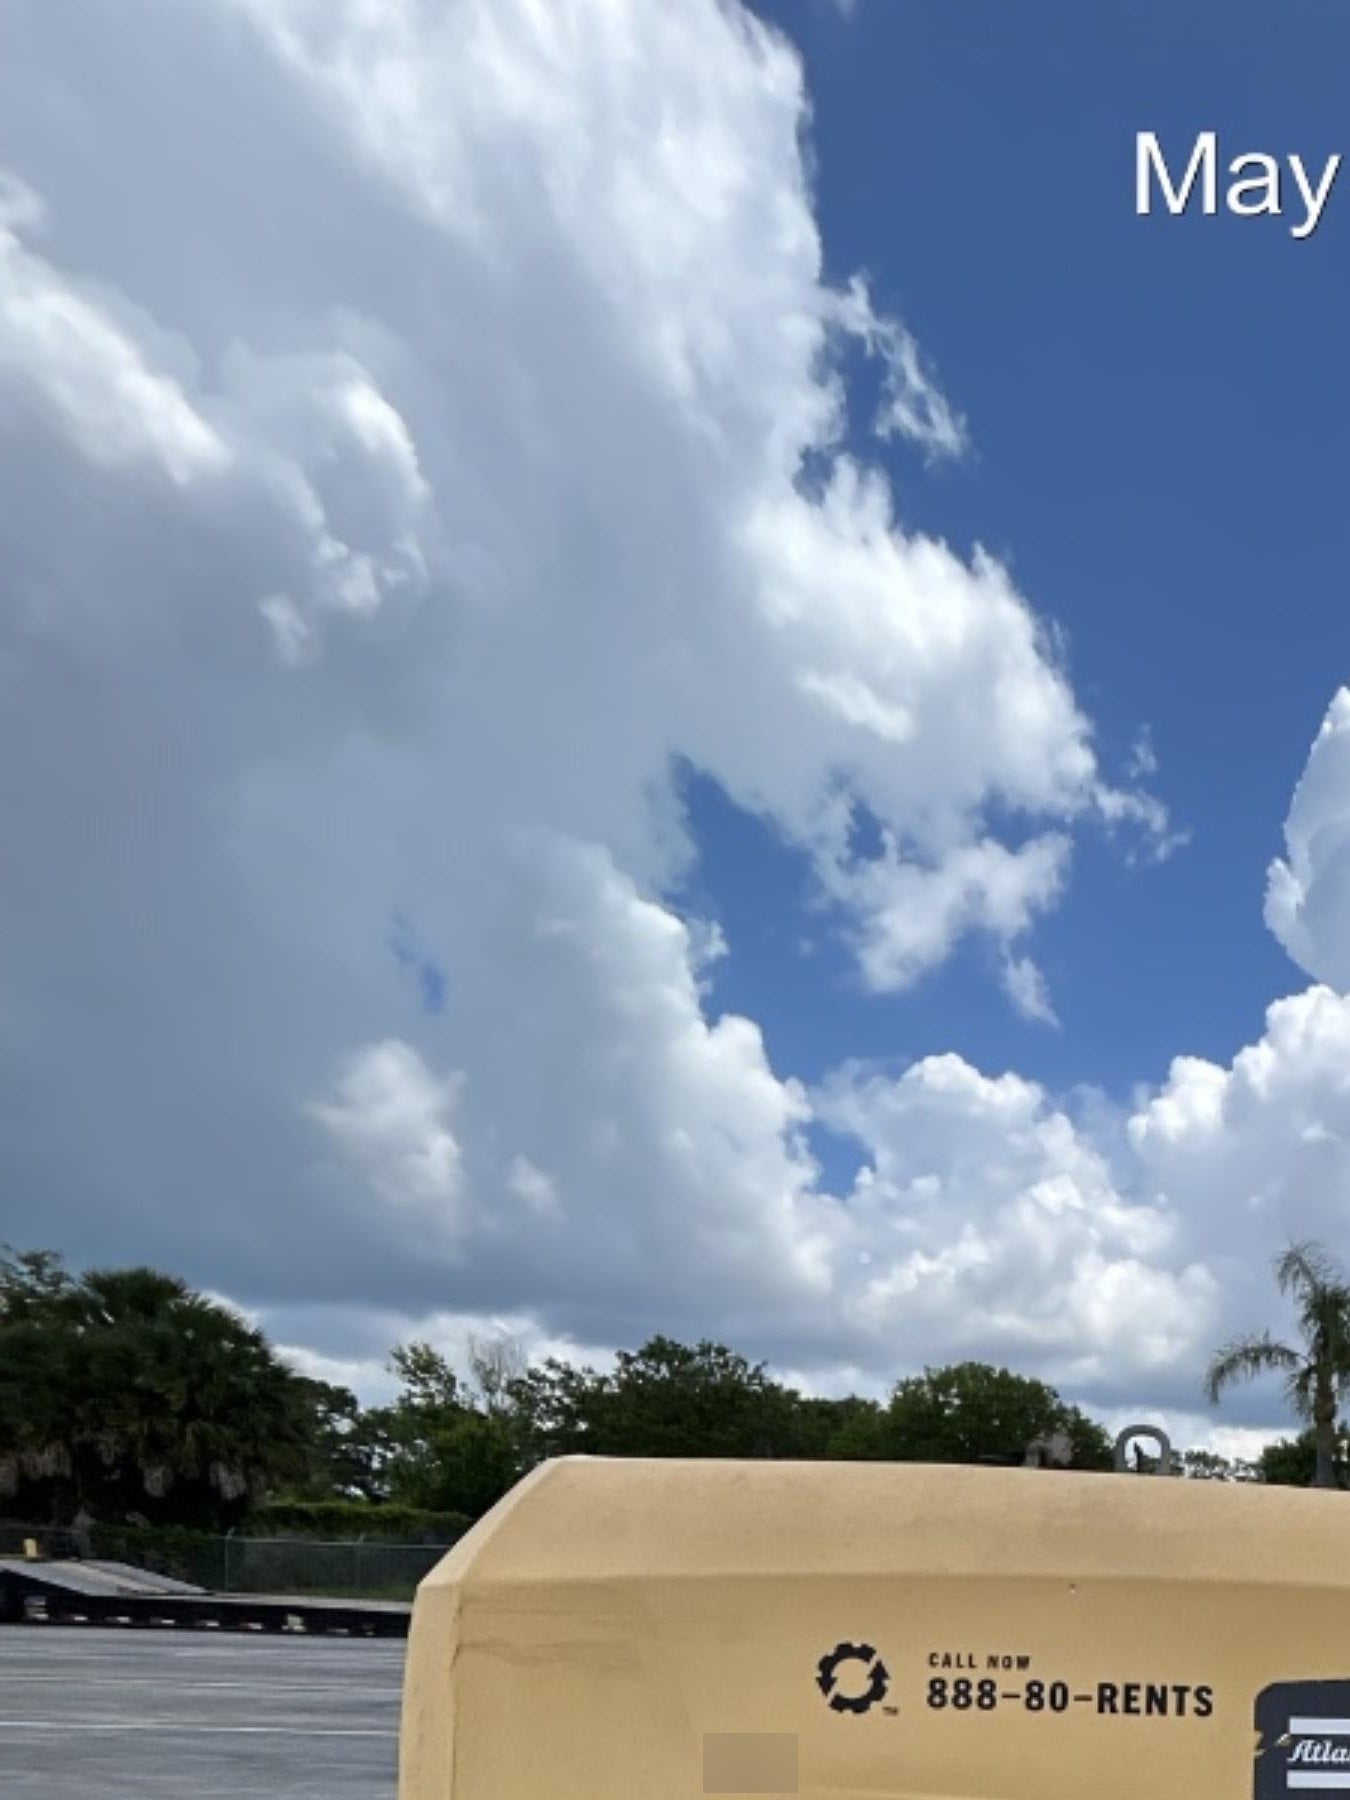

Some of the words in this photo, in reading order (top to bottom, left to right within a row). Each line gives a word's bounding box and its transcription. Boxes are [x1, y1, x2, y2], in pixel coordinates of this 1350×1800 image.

[928, 1652, 978, 1669] CALL
[987, 1654, 1031, 1670] NOW
[926, 1677, 1214, 1717] 888-80-RENTS
